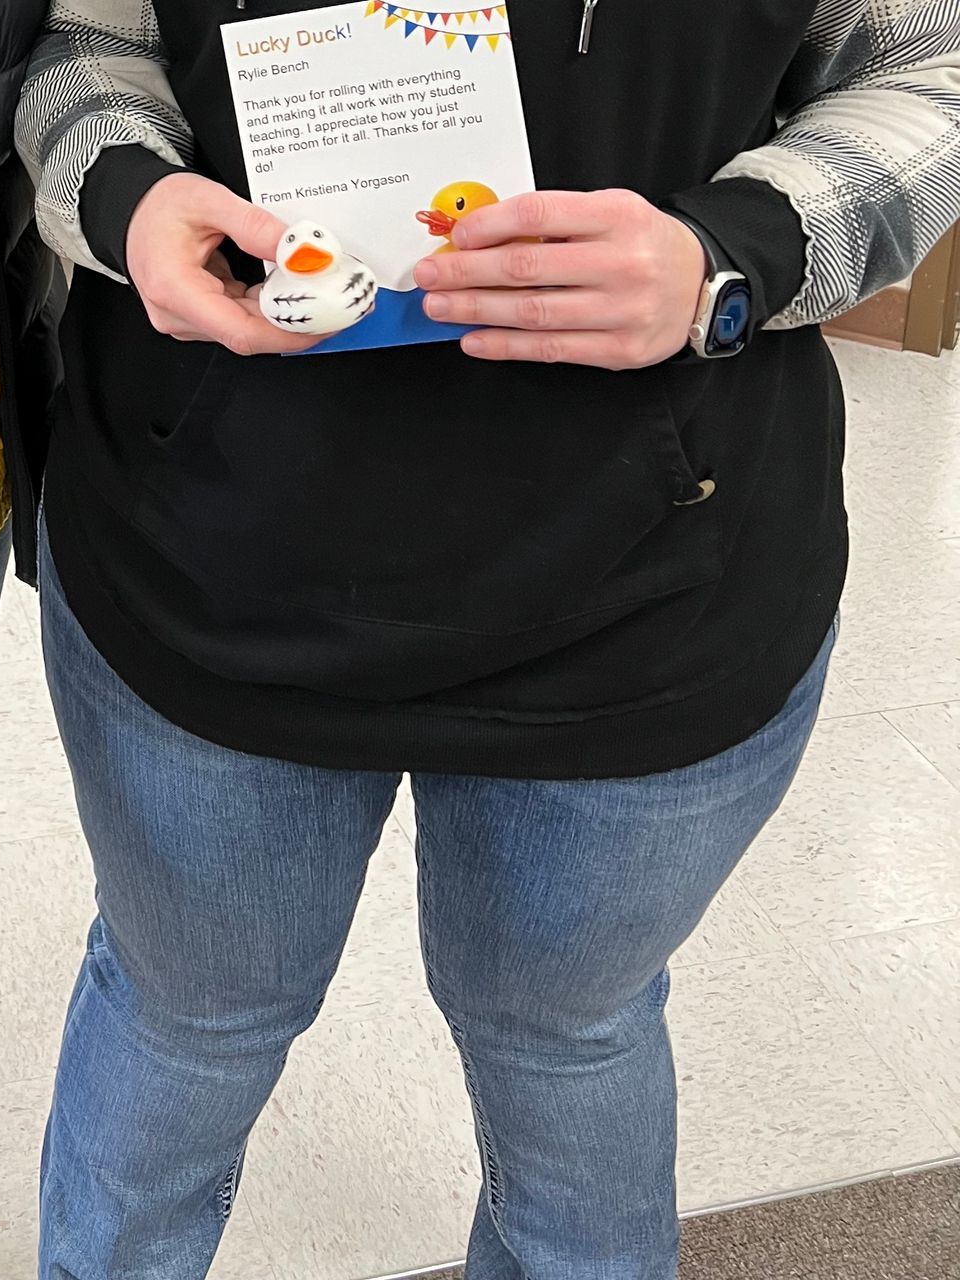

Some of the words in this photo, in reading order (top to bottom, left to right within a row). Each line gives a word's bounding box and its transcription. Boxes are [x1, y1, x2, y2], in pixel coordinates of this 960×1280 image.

[236, 35, 290, 57] Lucky
[296, 23, 352, 46] Duck!
[238, 67, 268, 82] Rylie
[271, 60, 310, 75] Bench
[243, 96, 281, 112] Thank
[284, 93, 306, 107] you
[309, 89, 325, 101] for
[329, 82, 366, 97] rolling
[368, 79, 394, 91] with
[397, 69, 461, 87] everything
[246, 114, 269, 128] and
[272, 108, 316, 123] making
[318, 105, 327, 116] it
[330, 102, 343, 114] all
[346, 98, 376, 111] work
[379, 93, 404, 106] with
[407, 91, 426, 102] my
[430, 82, 476, 98] student
[249, 126, 303, 143] teaching.
[307, 123, 311, 133] I
[314, 114, 378, 133] appreciate
[381, 109, 407, 122] how
[410, 106, 433, 120] you
[436, 101, 459, 116] just
[252, 144, 285, 158] make
[289, 139, 320, 152] room
[322, 134, 338, 147] for
[341, 133, 350, 143] it
[352, 130, 370, 141] all.
[374, 123, 419, 138] Thanks
[421, 120, 438, 131] for
[442, 116, 456, 128] all
[460, 115, 483, 128] you
[255, 161, 273, 174] do!
[261, 191, 292, 204] From
[295, 181, 348, 199] Kristiena
[351, 172, 410, 190] Yorgason
